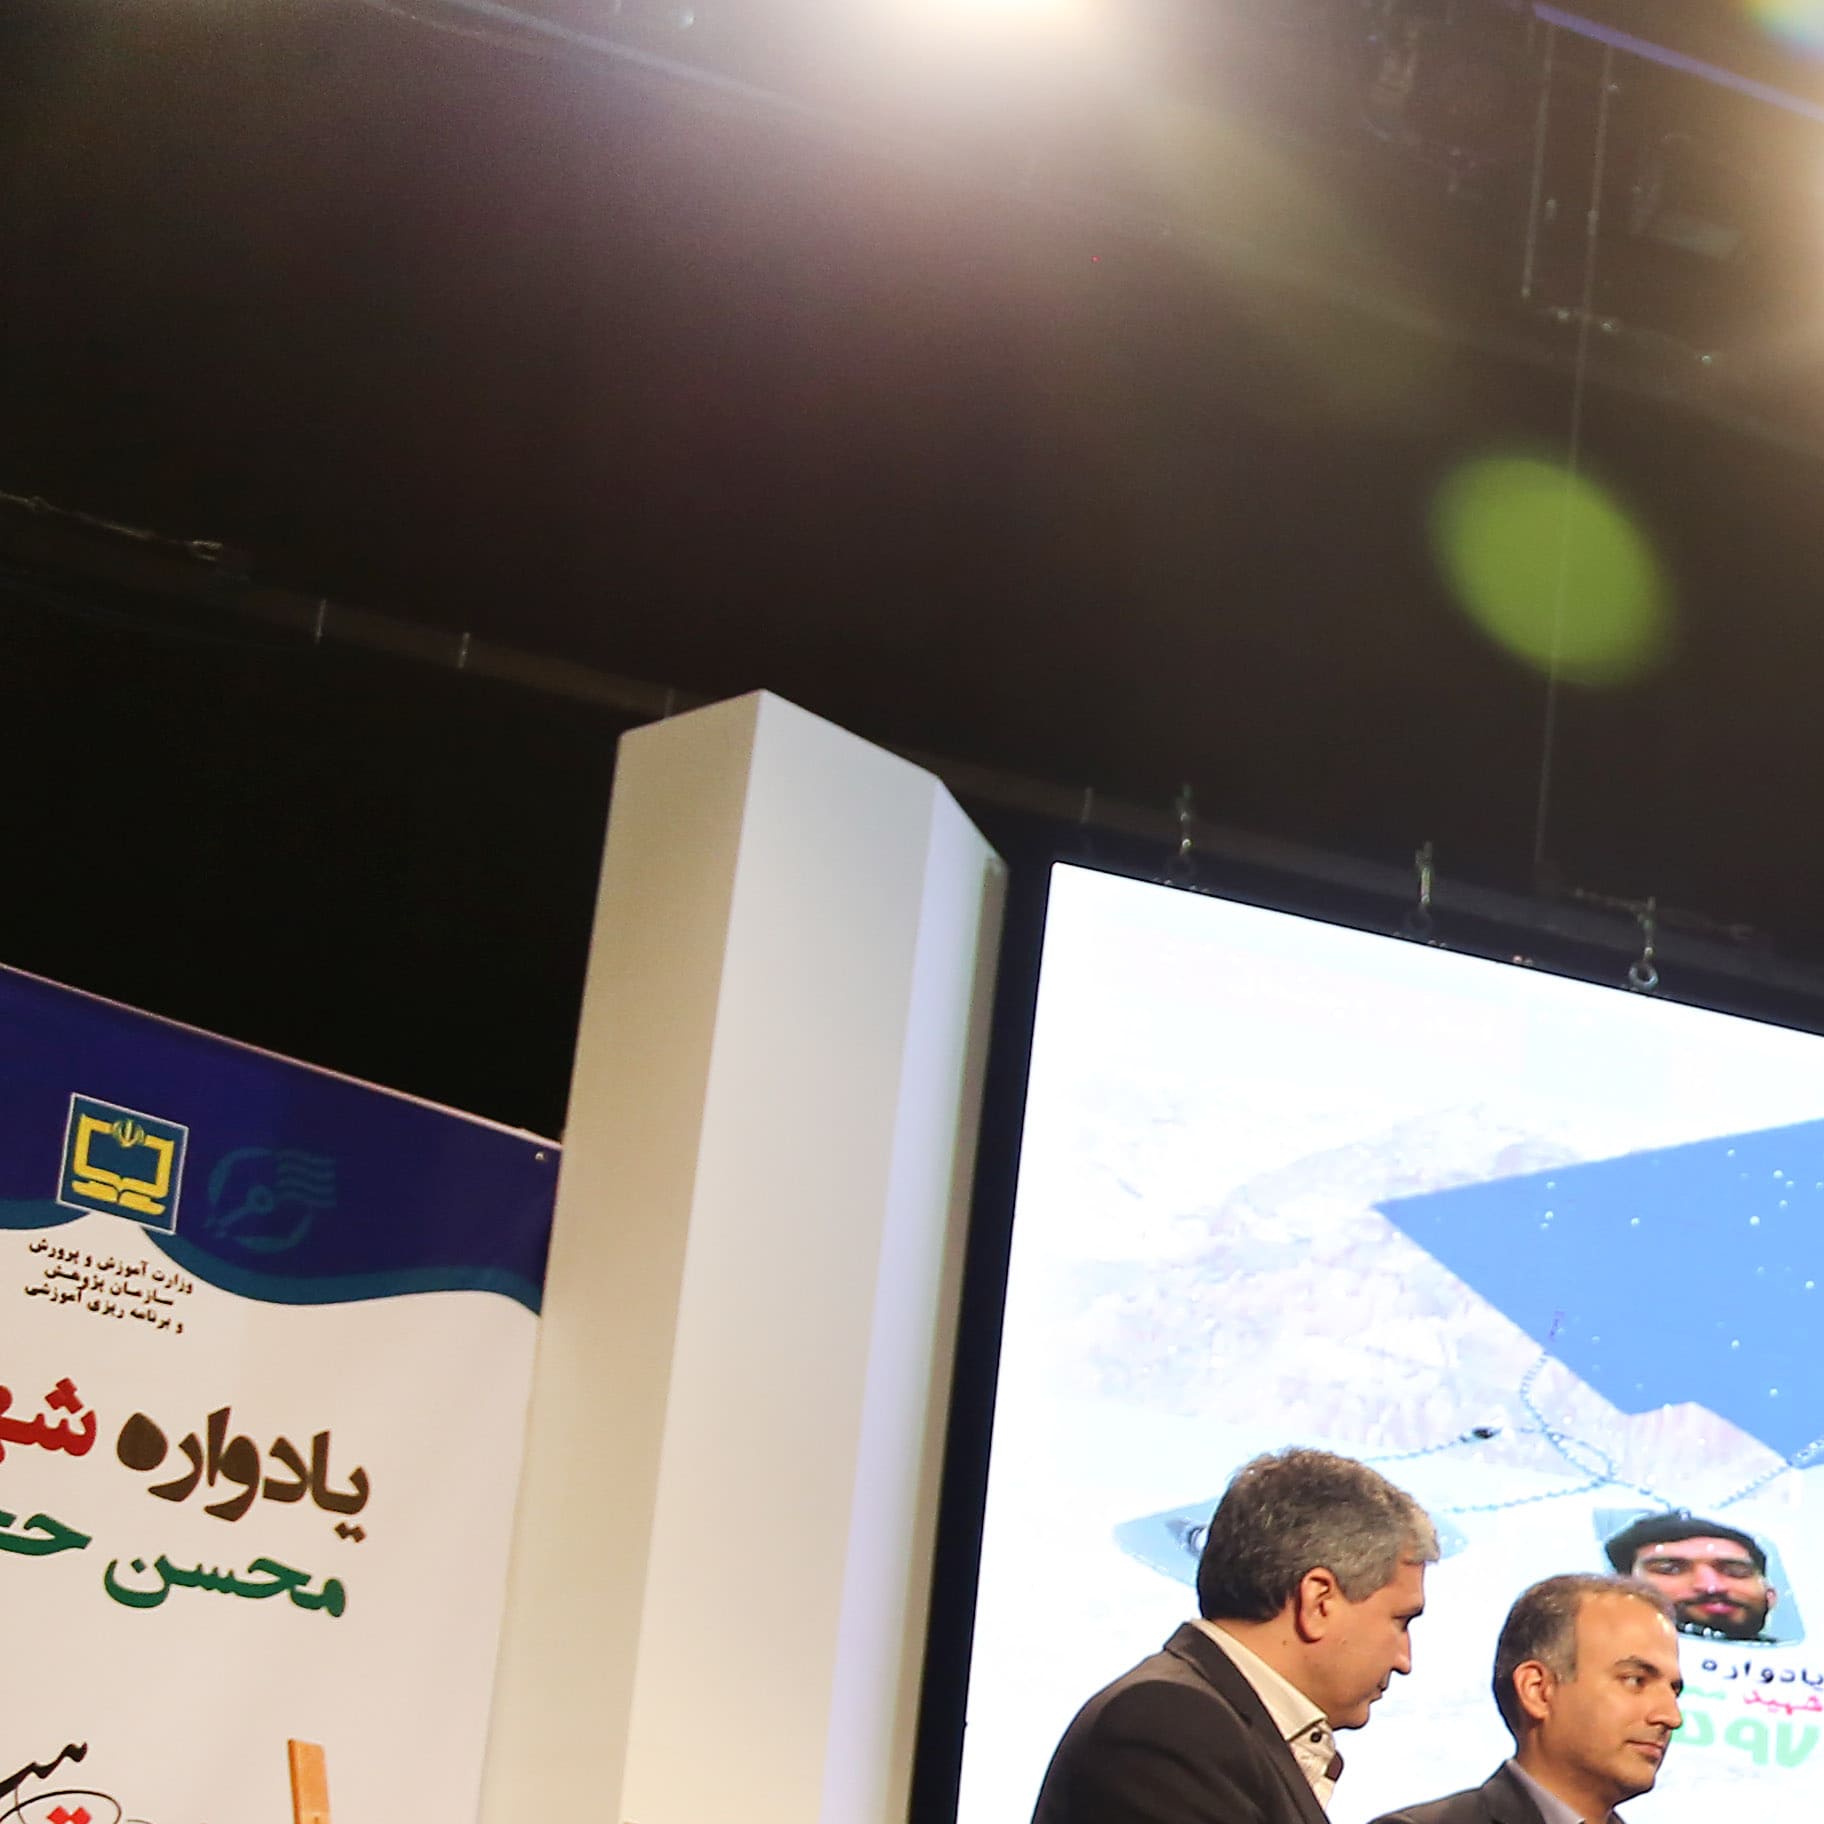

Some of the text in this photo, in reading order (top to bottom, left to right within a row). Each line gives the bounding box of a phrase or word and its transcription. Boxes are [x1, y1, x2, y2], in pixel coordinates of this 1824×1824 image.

[28, 1238, 193, 1294] وزارت آموزش و پرورش
[44, 1264, 174, 1306] سازمان پژوهش
[24, 1282, 184, 1334] و برنامه ریزی آموزشی
[116, 1405, 370, 1544] یادواره
[103, 1554, 346, 1618] محسن
[1743, 1689, 1824, 1716] شهید
